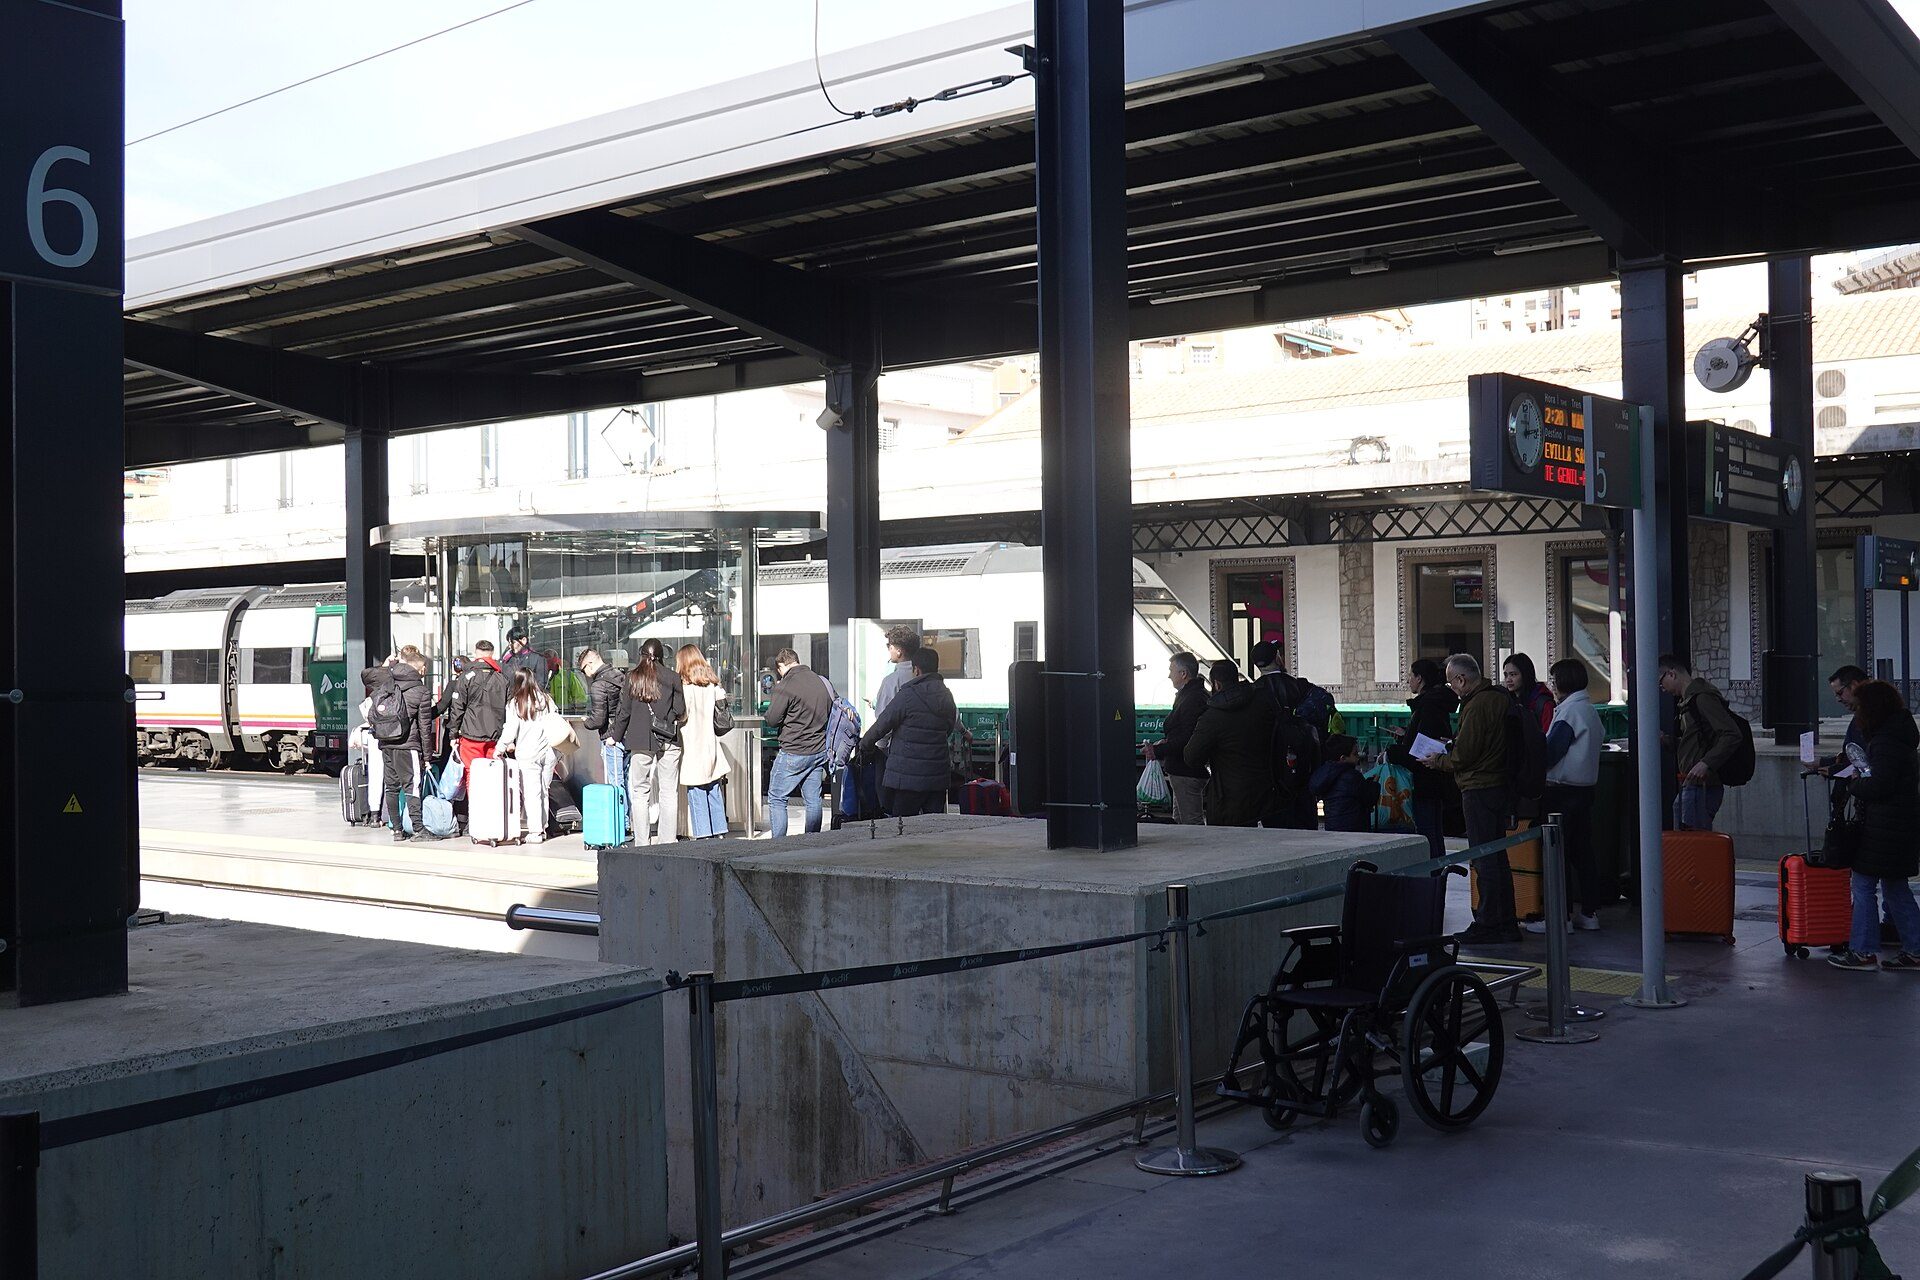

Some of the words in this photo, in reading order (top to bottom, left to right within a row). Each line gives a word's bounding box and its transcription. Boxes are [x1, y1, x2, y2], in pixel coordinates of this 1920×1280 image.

[27, 145, 98, 268] 6
[1596, 451, 1607, 499] 5
[1714, 471, 1724, 505] 4
[1140, 719, 1164, 731] renfe
[901, 964, 919, 975] adif
[830, 972, 850, 984] adif
[752, 981, 773, 993] adif
